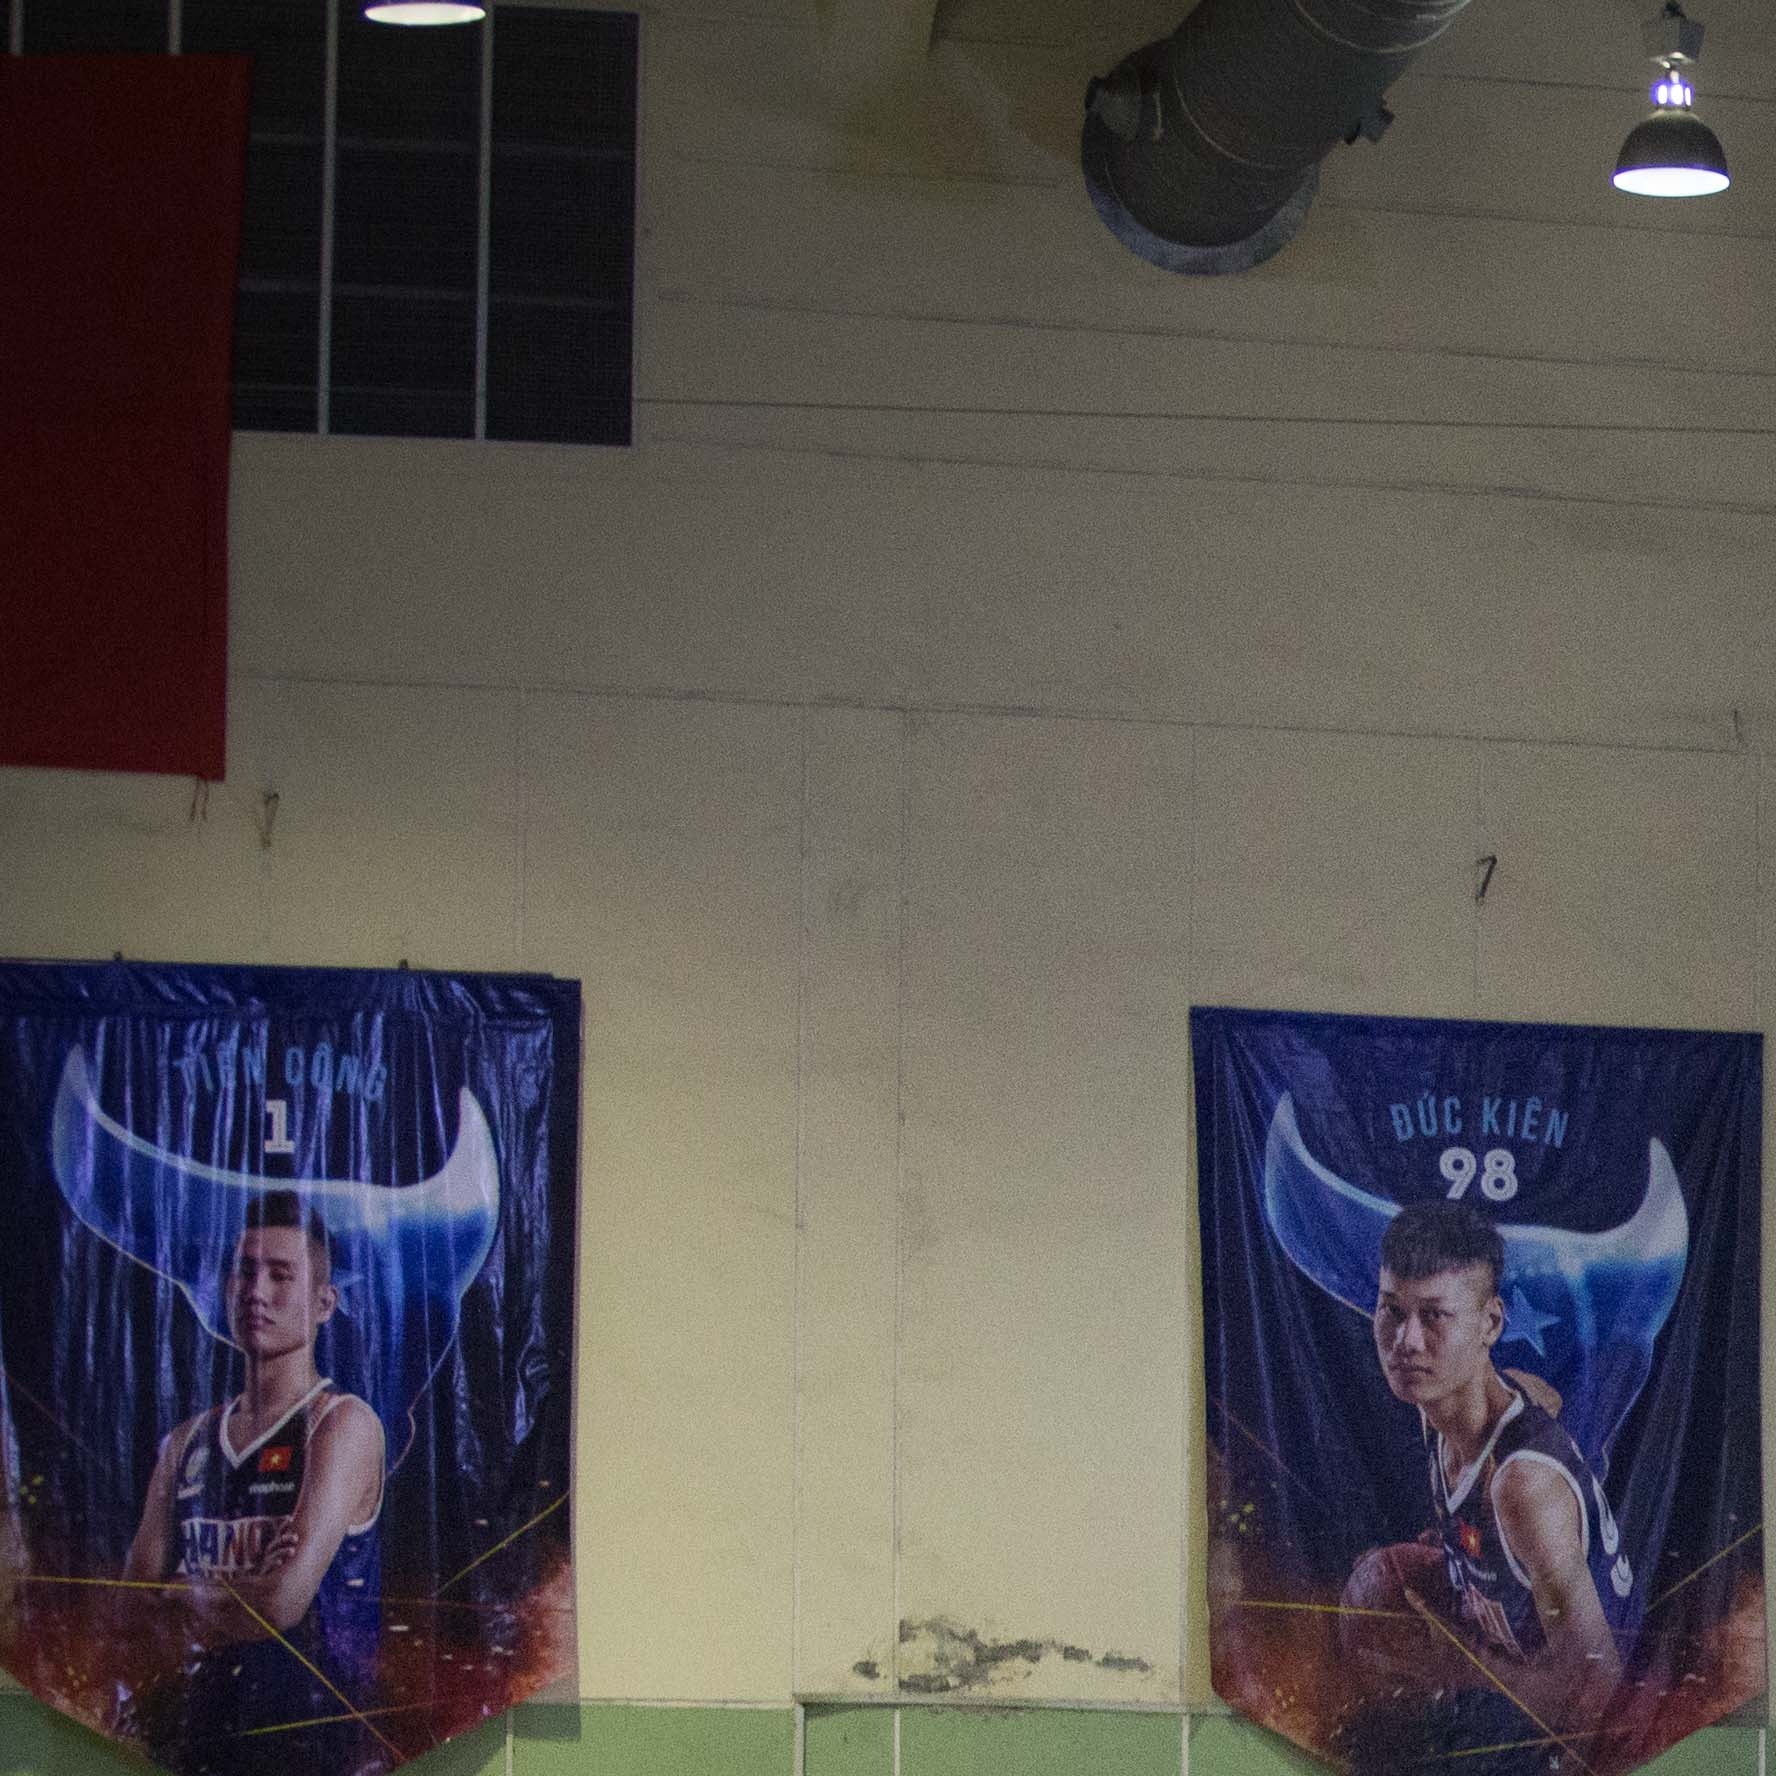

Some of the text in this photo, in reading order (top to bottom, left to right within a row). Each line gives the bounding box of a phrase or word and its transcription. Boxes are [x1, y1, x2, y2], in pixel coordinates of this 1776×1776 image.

[264, 1099, 296, 1154] 1
[1390, 1090, 1462, 1143] ĐỨC
[1439, 1146, 1519, 1201] 98
